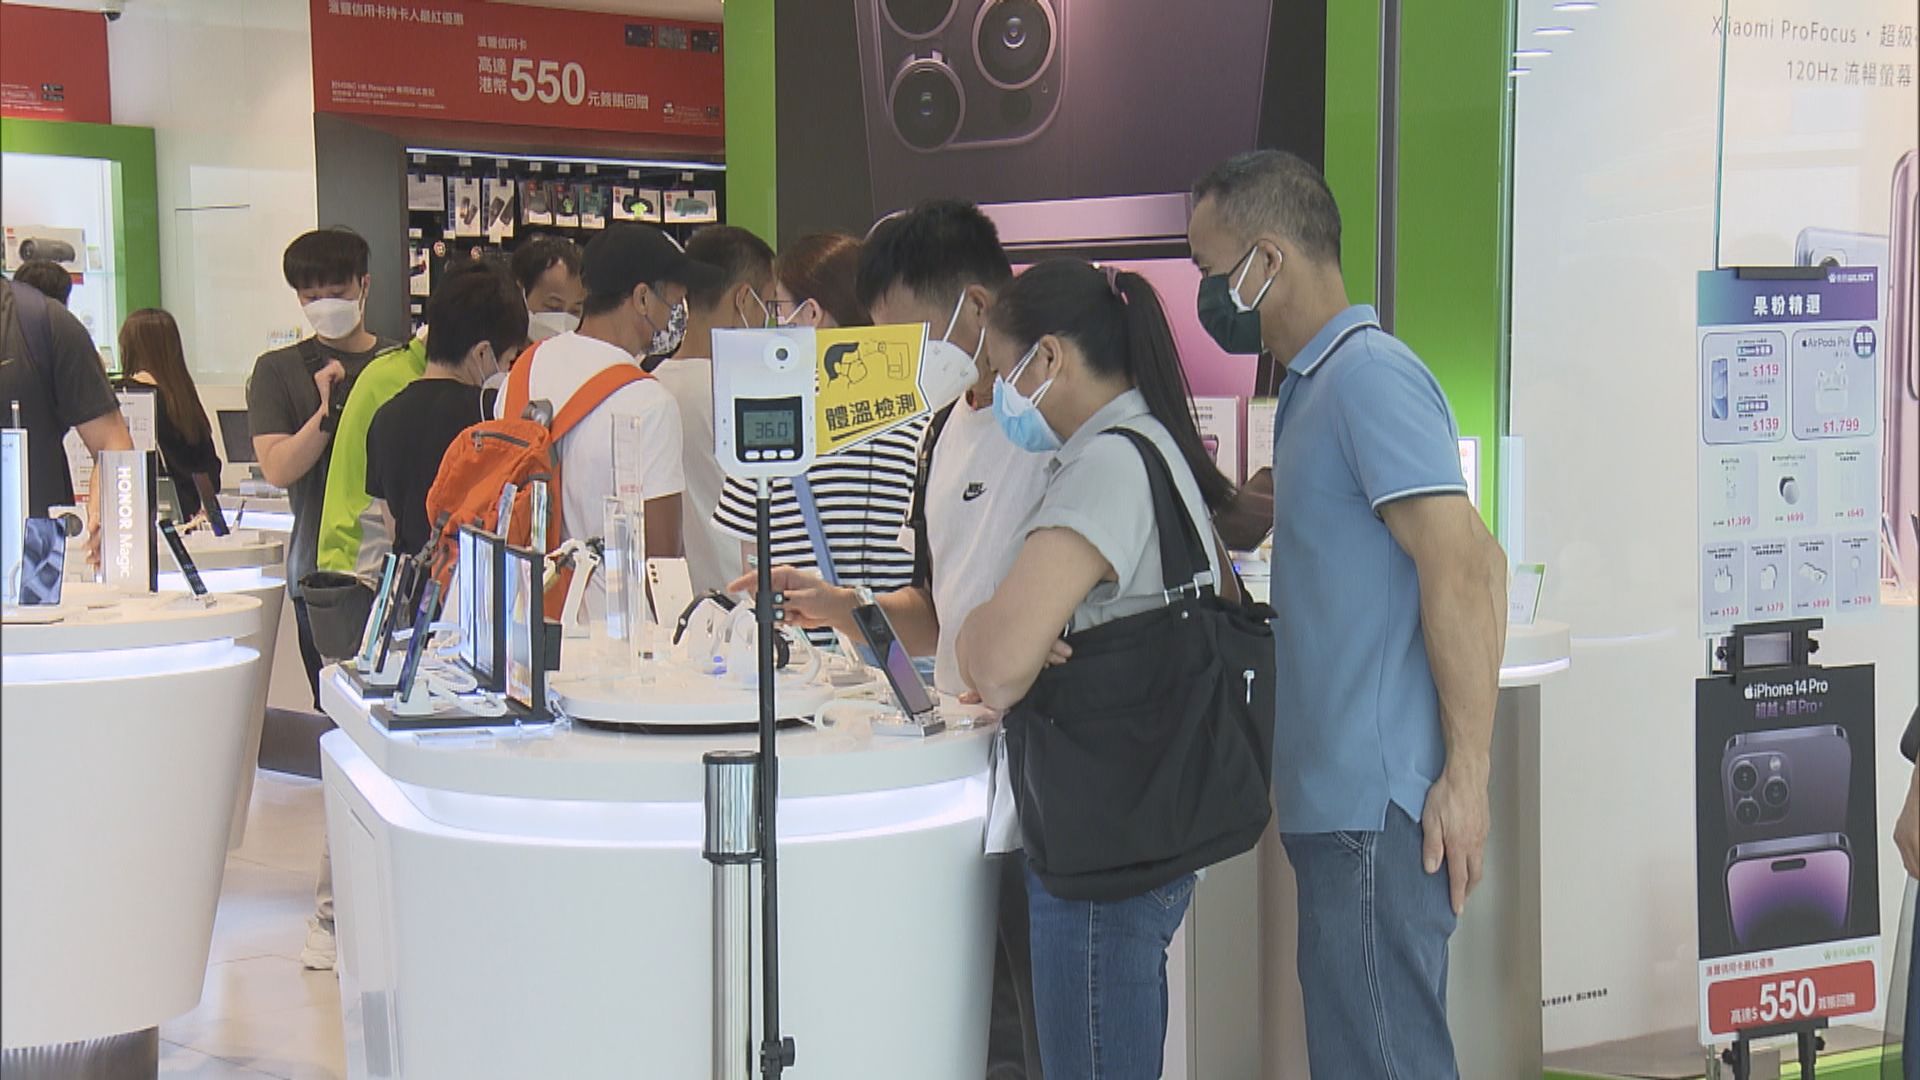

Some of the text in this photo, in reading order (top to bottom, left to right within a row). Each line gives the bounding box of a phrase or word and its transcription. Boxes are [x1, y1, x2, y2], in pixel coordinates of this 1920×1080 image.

[1711, 15, 1918, 48] Xiaomi ProFocus 超級
[478, 56, 507, 75] 高達
[1787, 60, 1839, 82] 120Hz
[479, 77, 507, 94] 港幣
[511, 58, 586, 105] 550
[1753, 293, 1821, 316] 果粉精選
[1808, 336, 1836, 348] AirPods
[1753, 363, 1779, 378] $119
[826, 391, 917, 431] 體溫檢測
[1753, 417, 1779, 432] $139
[115, 465, 134, 578] HONOR Magic
[1753, 678, 1829, 699] iPhone 14 Pro
[1759, 977, 1816, 1022] 550
